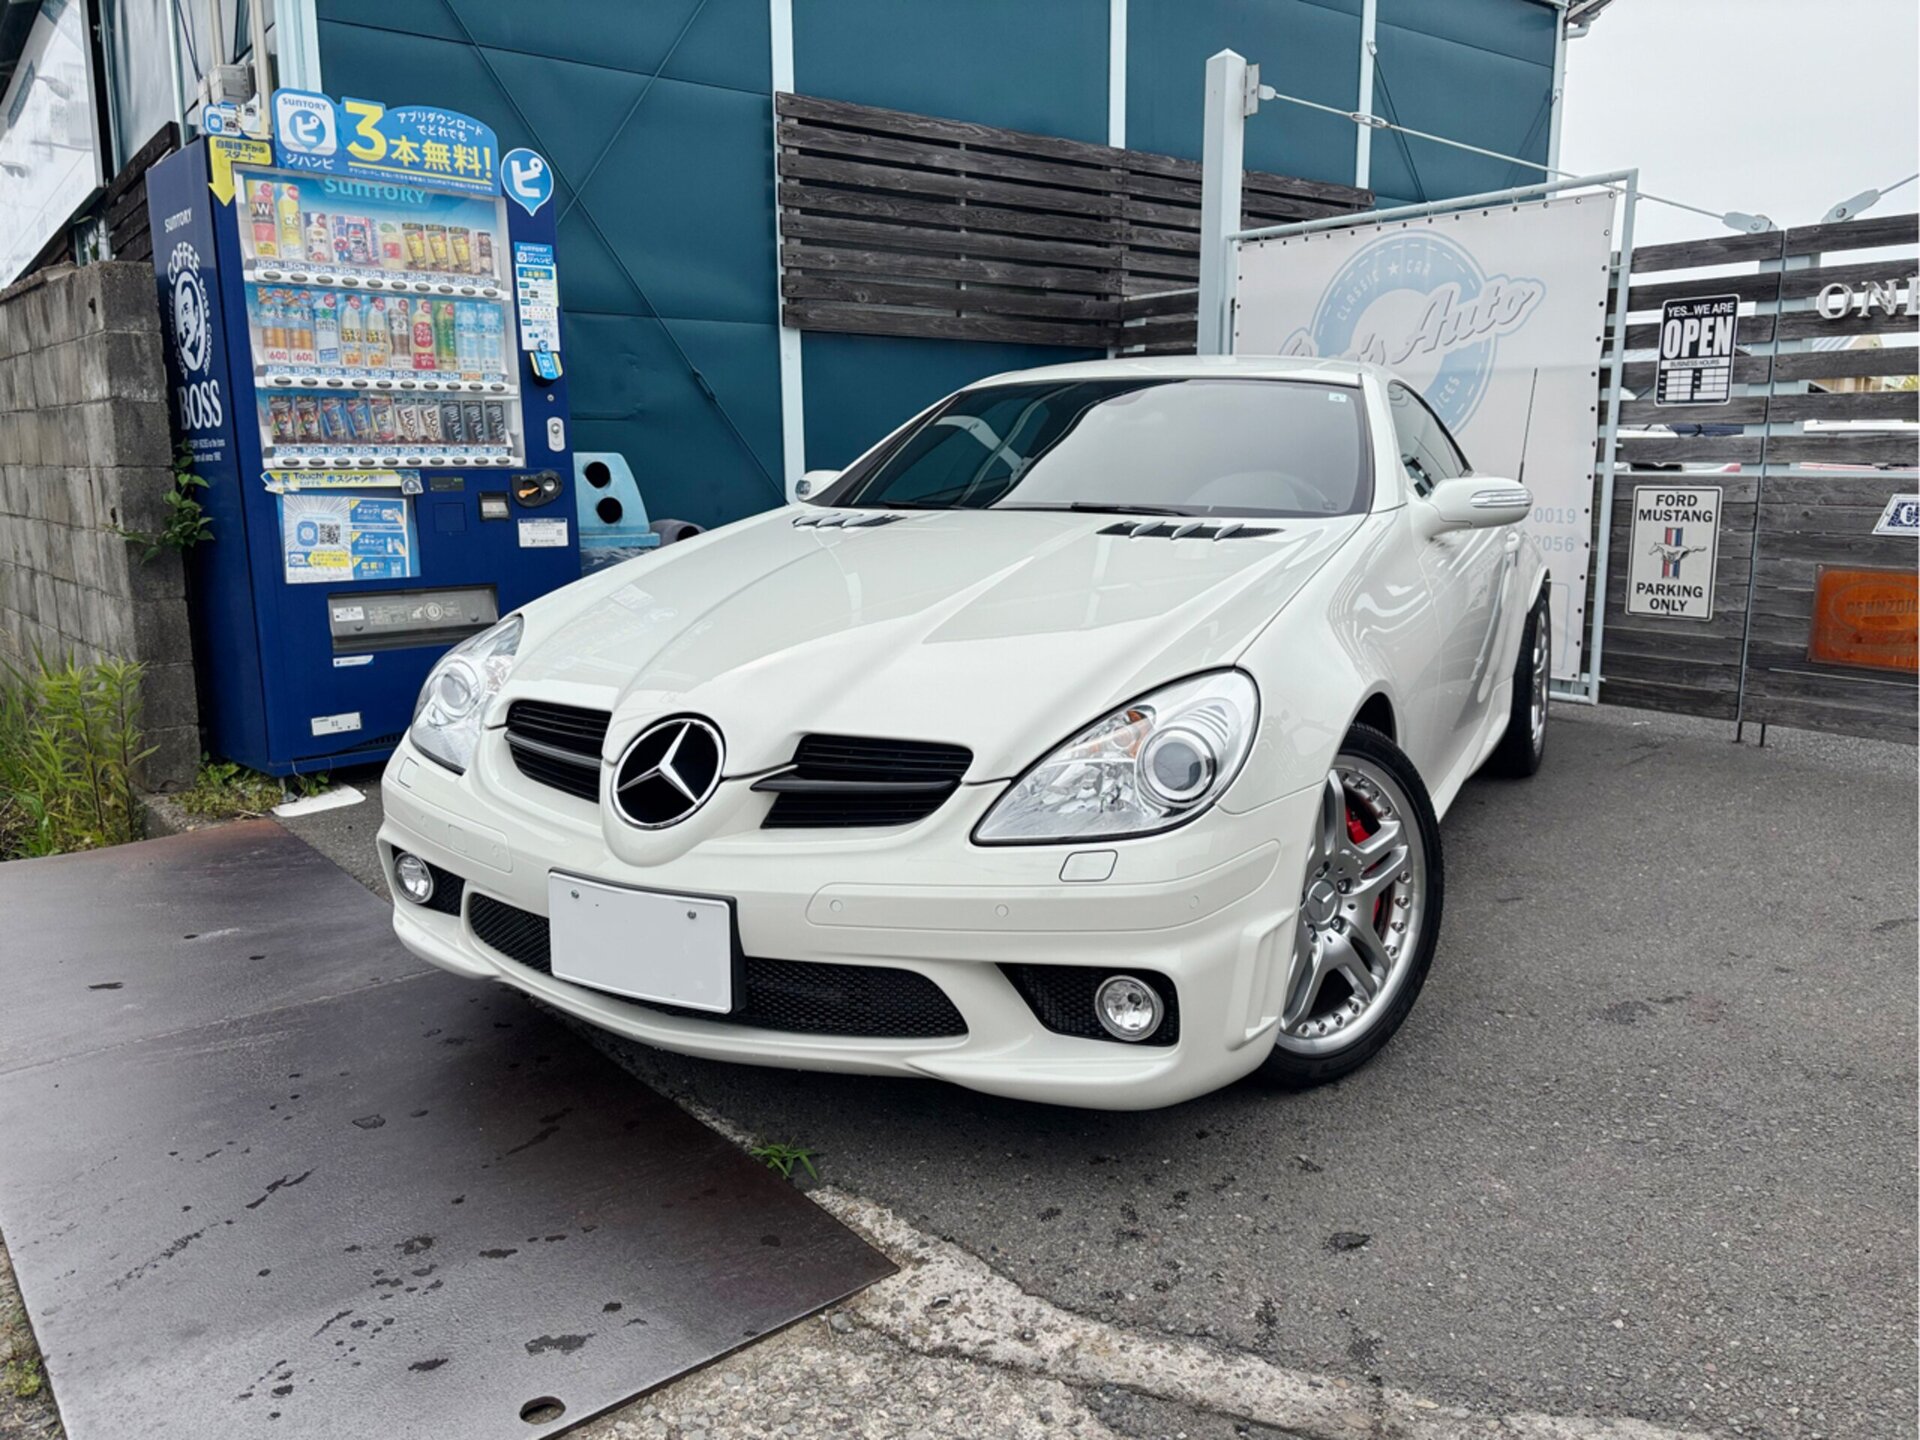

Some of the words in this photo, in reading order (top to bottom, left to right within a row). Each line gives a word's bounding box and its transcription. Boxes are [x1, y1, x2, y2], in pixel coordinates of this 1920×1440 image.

[397, 111, 483, 136] アプリダウンロード
[416, 124, 467, 142] でどれでも
[167, 241, 201, 286] COFFEE
[1337, 269, 1380, 321] CLASSIC
[1406, 258, 1432, 276] CAR
[1712, 301, 1735, 314] ARE
[1391, 284, 1536, 366] Auto
[1662, 315, 1734, 359] OPEN
[177, 378, 222, 431] BOSS
[1655, 494, 1698, 507] FORD
[1638, 509, 1713, 523] MUSTANG
[1636, 582, 1703, 598] PARKING
[1649, 598, 1688, 612] ONLY
